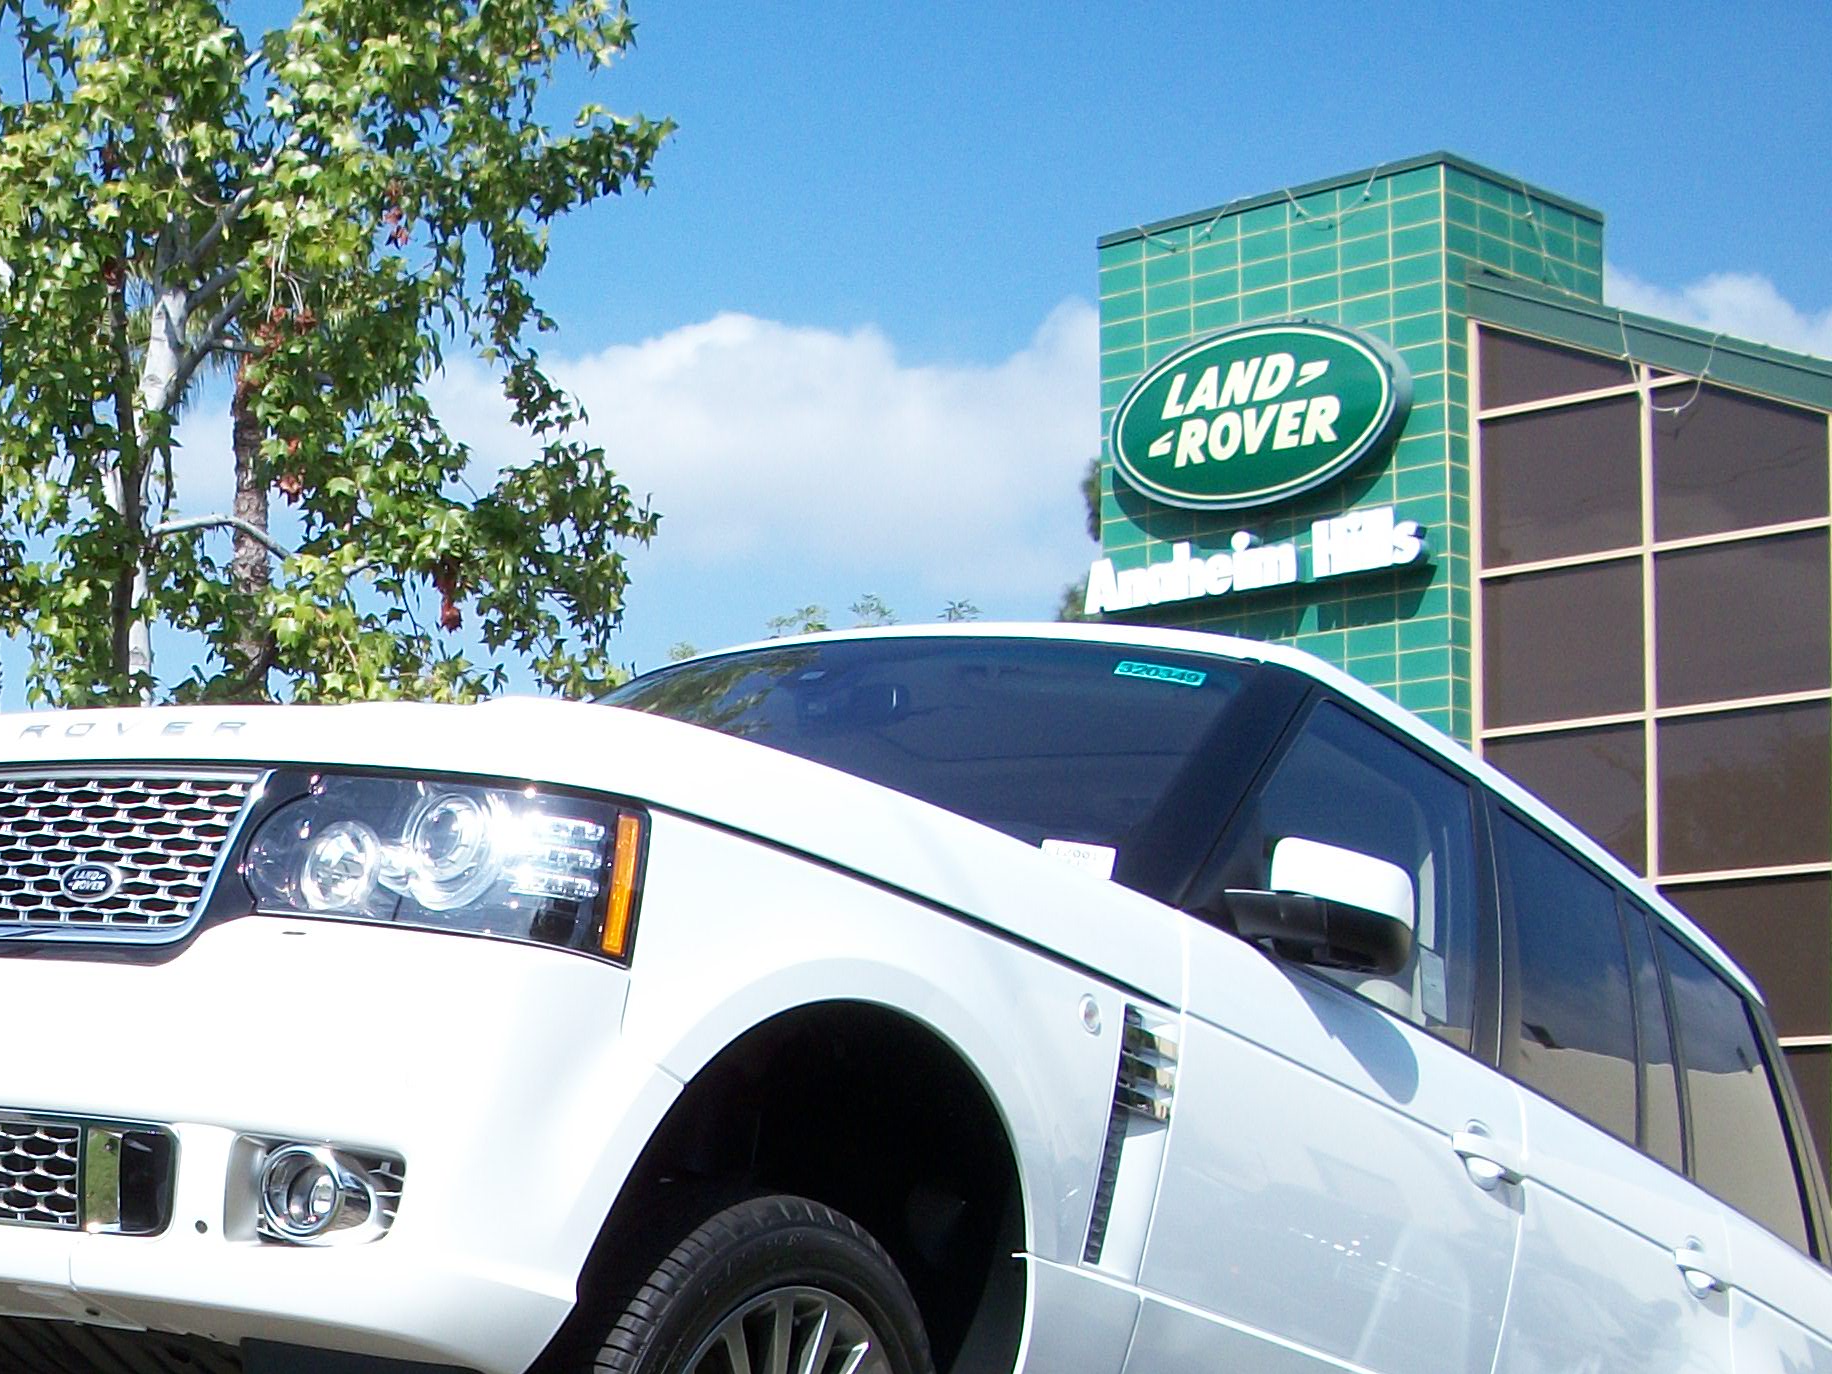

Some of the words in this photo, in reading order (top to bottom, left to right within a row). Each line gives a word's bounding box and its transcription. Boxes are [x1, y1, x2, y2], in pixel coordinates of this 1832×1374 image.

[1161, 352, 1294, 420] LAND
[1173, 395, 1341, 468] ROVER
[1084, 530, 1298, 615] Anaheim
[1311, 506, 1424, 578] Hills
[20, 721, 247, 740] ROVER
